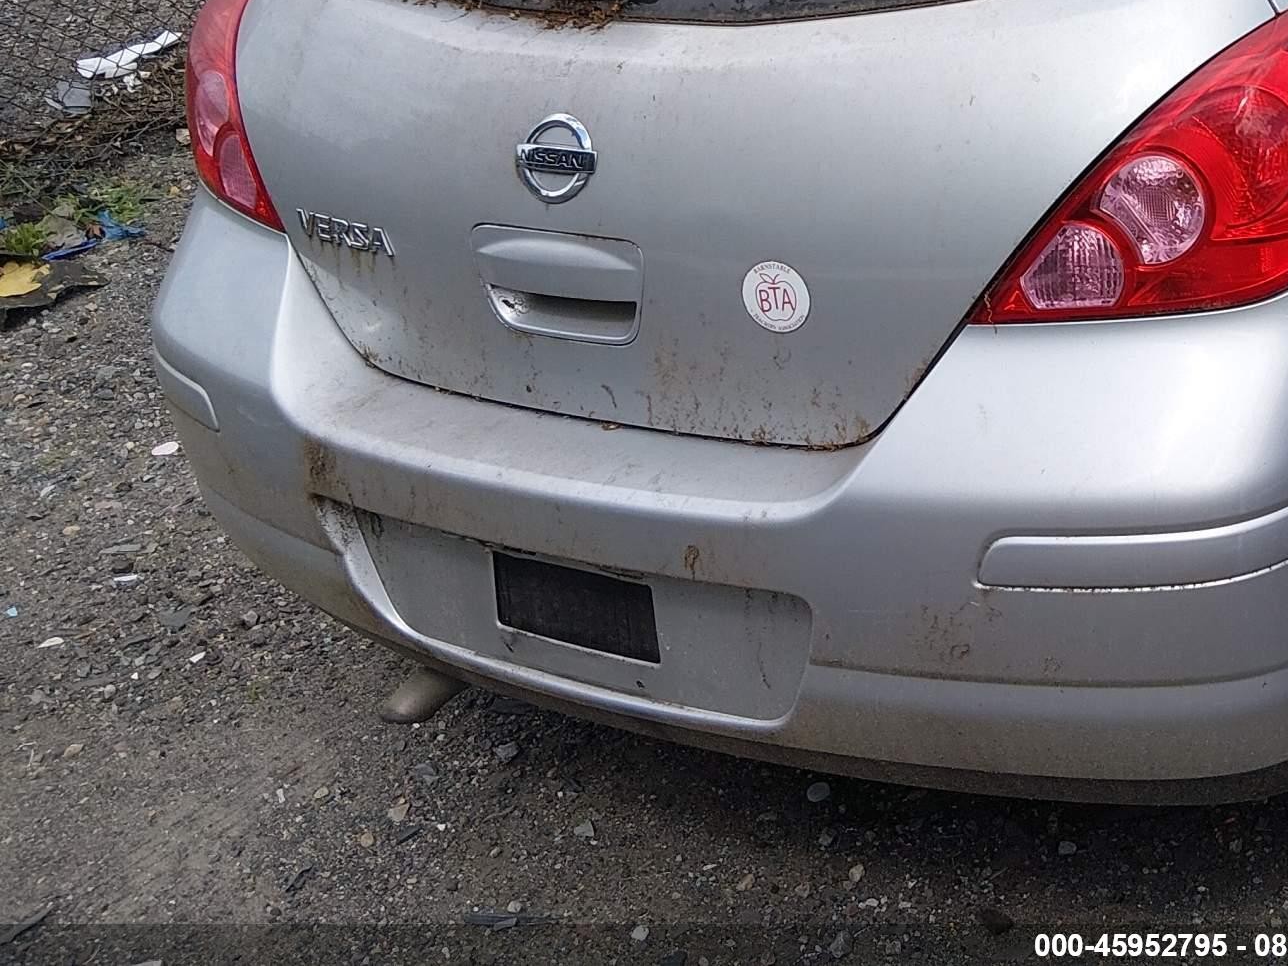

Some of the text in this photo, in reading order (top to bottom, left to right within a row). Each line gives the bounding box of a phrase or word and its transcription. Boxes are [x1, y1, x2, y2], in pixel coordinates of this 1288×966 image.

[519, 148, 585, 169] NISSAN
[296, 207, 396, 256] VERSA
[759, 286, 796, 312] BTA
